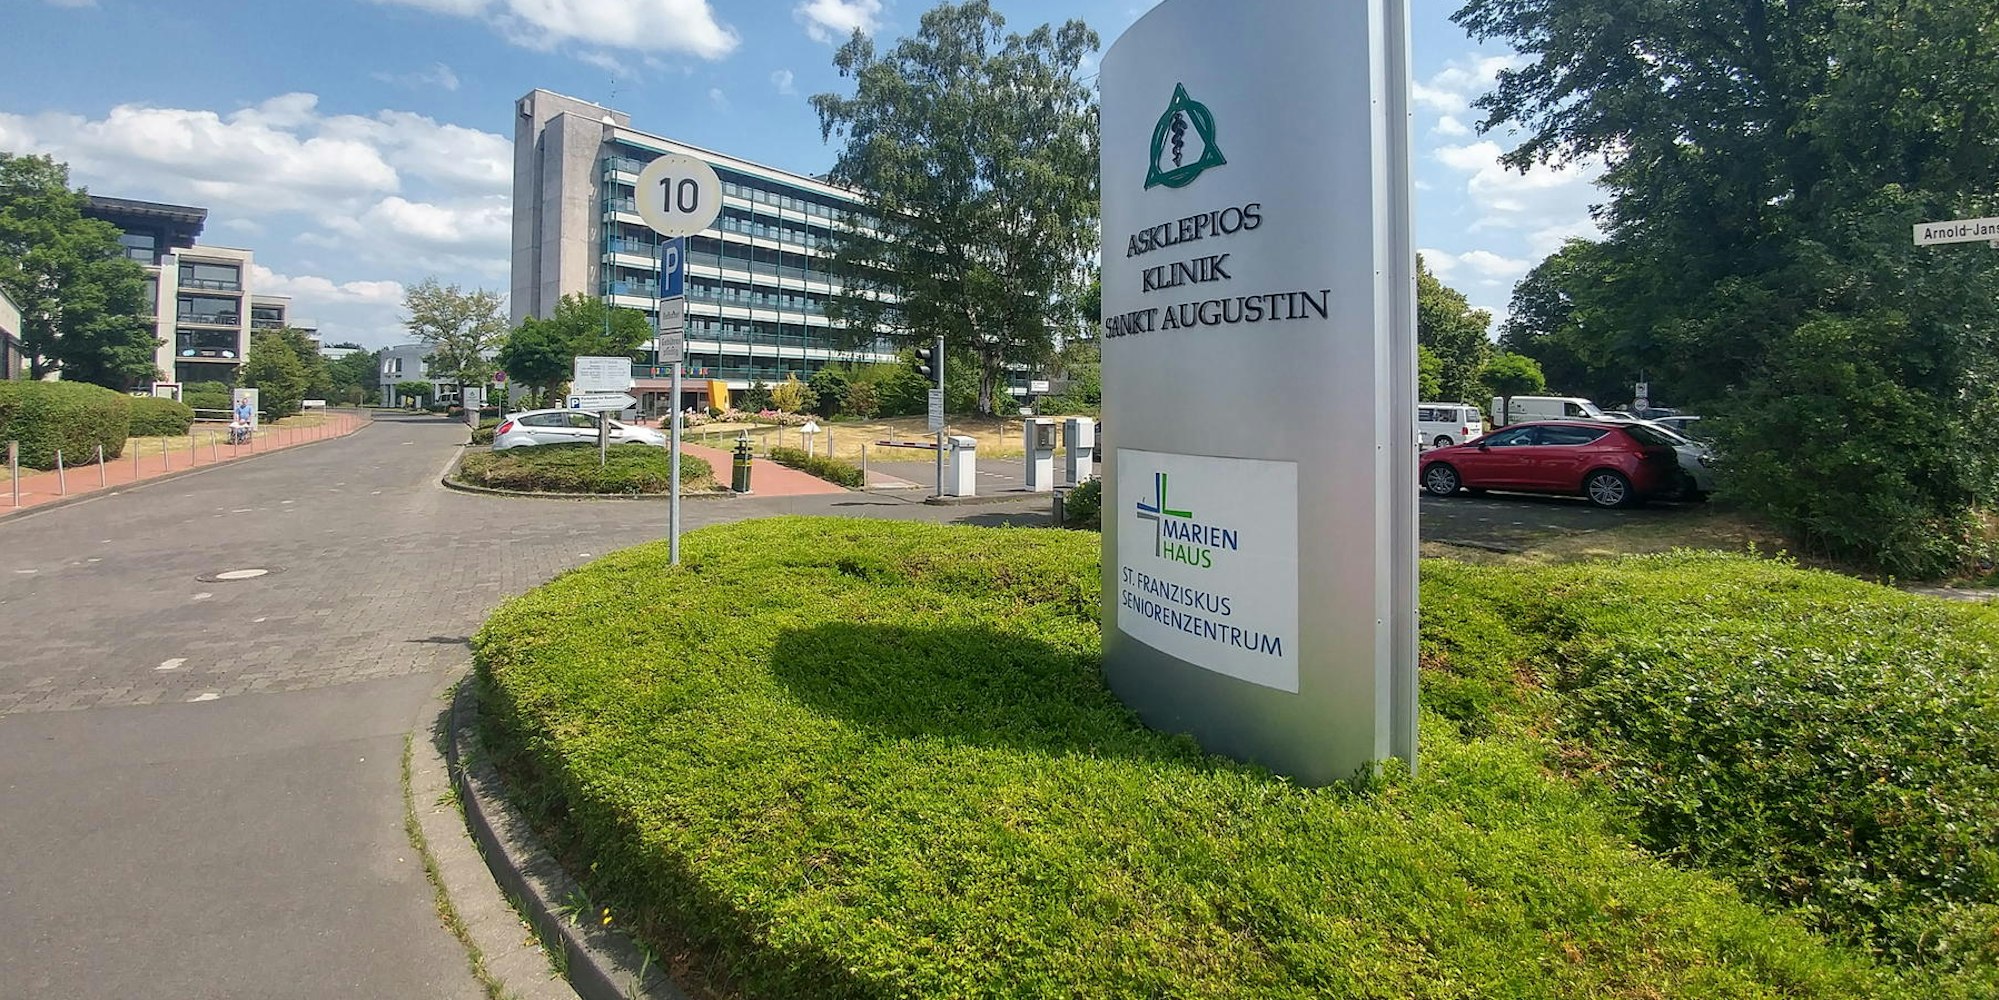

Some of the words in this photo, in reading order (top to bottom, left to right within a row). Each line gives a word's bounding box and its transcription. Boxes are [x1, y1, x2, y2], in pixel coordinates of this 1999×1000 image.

[659, 177, 699, 214] 10
[1126, 203, 1263, 259] ASKLEPIOS
[665, 246, 679, 291] P
[1142, 253, 1231, 293] KLINIK
[1105, 307, 1158, 339] SANKT
[1161, 289, 1331, 330] AUGUSTIN
[1163, 519, 1238, 550] MARIEN
[1163, 541, 1212, 569] HAUS
[1122, 566, 1135, 586] ST.
[1137, 572, 1231, 616] FRANZISKUS
[1122, 589, 1282, 657] SENIORENZENTRUM
